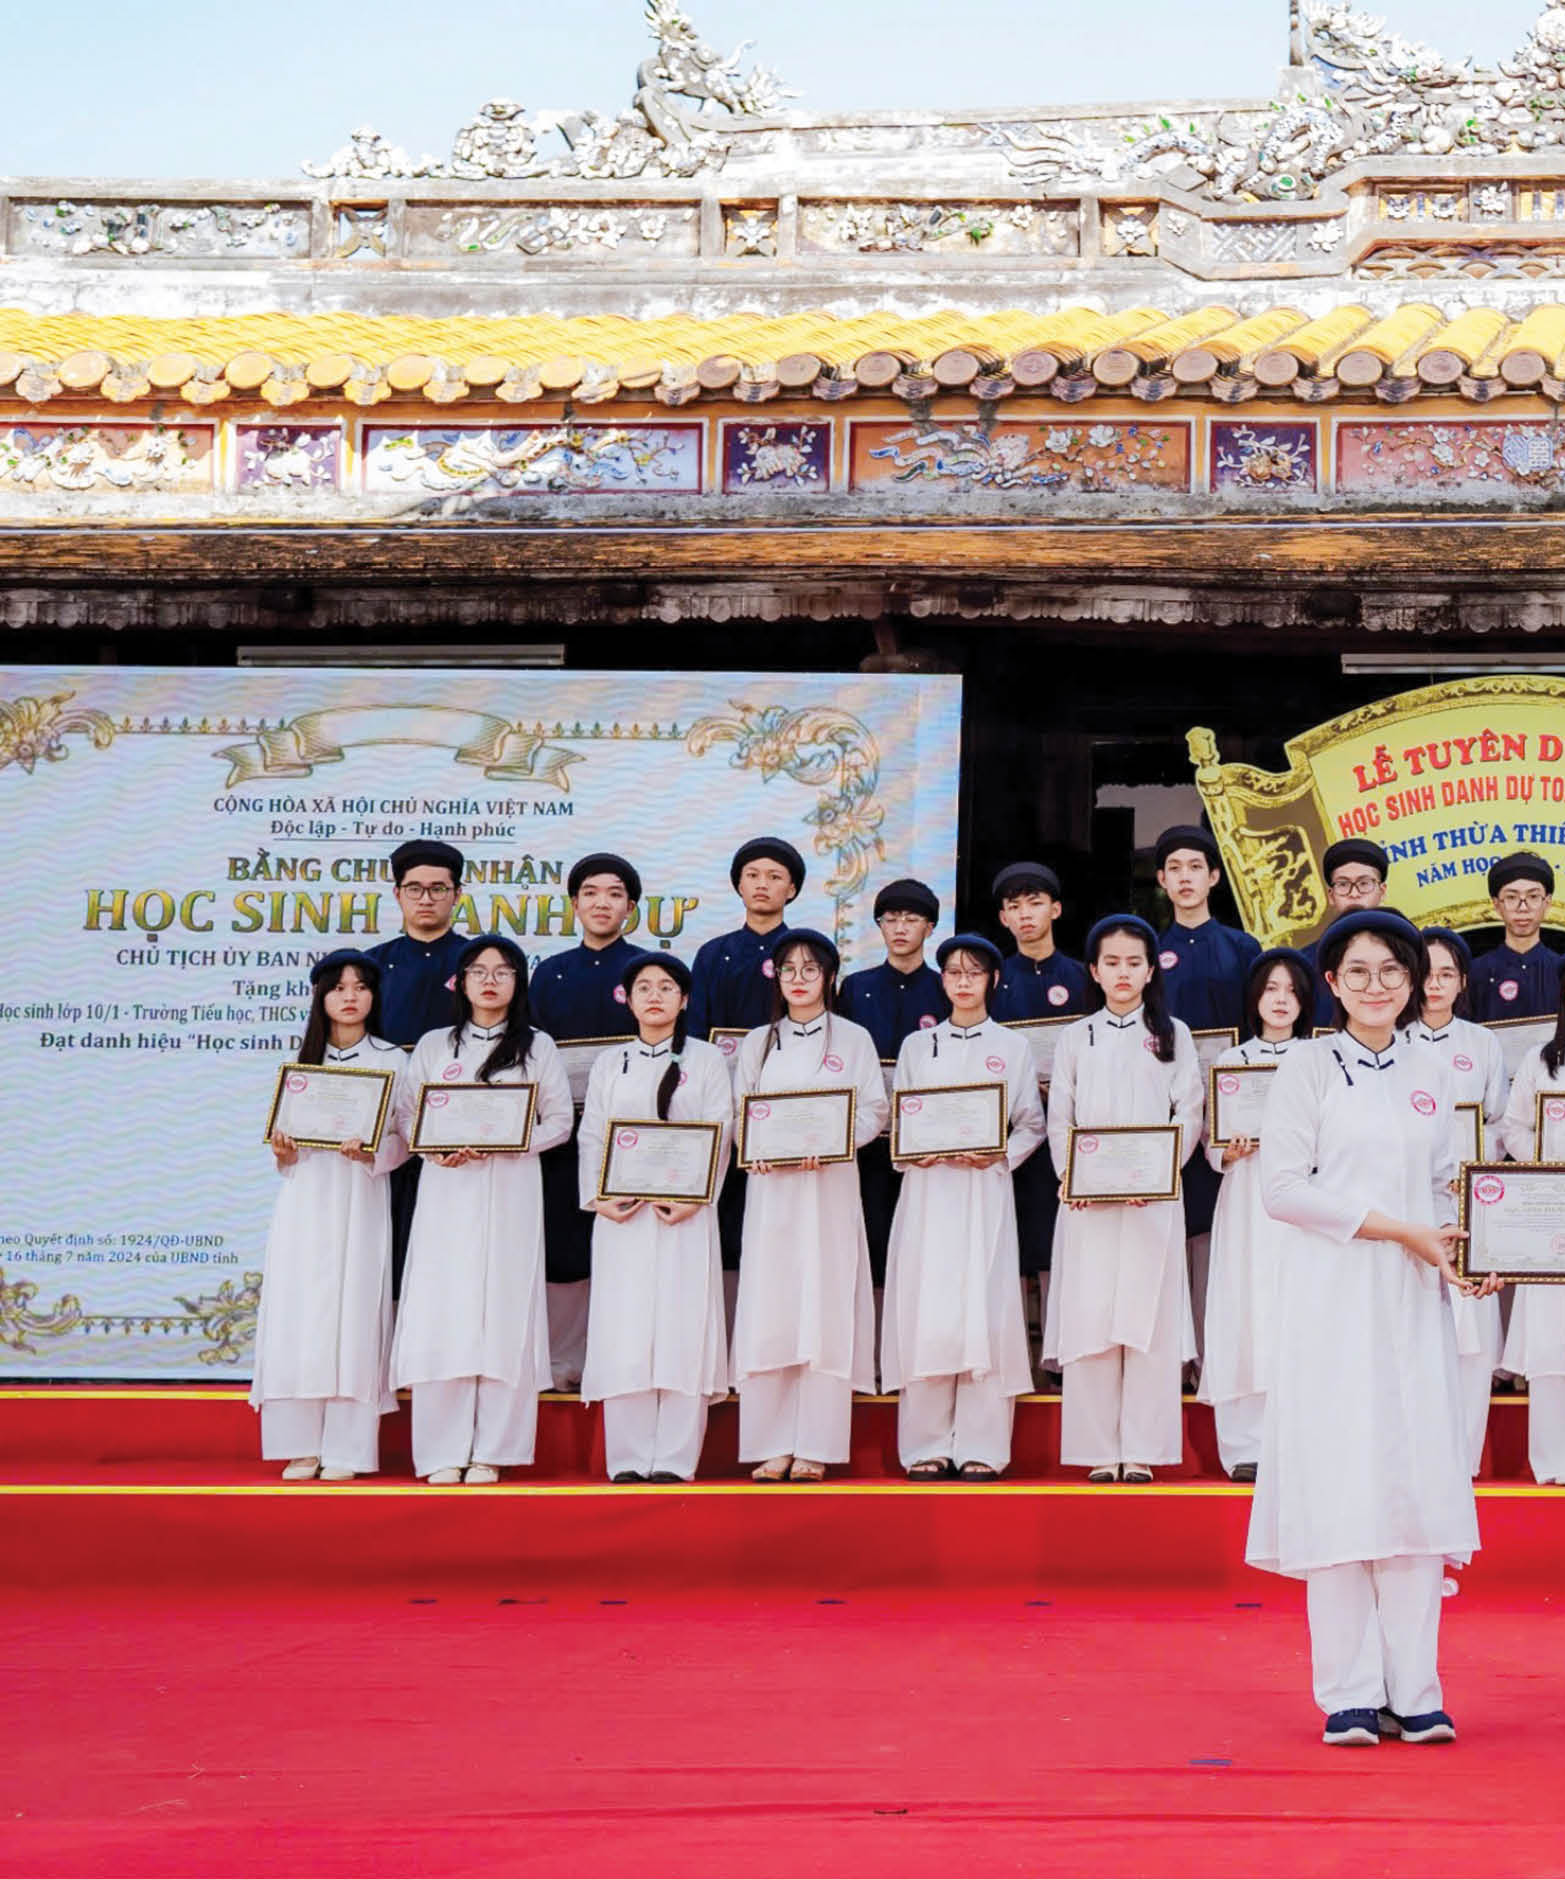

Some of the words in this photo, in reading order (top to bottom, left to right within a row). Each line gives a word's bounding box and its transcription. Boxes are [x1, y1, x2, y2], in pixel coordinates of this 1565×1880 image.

[1353, 744, 1398, 792] LỄ
[1402, 728, 1528, 775] TUYÊN
[214, 797, 264, 814] CỘNG
[269, 797, 307, 813] HÒA
[312, 798, 336, 813] XÃ
[342, 798, 375, 816] HỘI
[380, 797, 417, 814] CHỦ
[422, 799, 480, 815] NGHĨA
[486, 799, 526, 818] VIỆT
[533, 801, 574, 816] NAM
[1338, 802, 1381, 839] HỌC
[1385, 784, 1436, 820] SINH
[1441, 775, 1498, 806] DANH
[1505, 773, 1535, 805] DỰ
[271, 819, 304, 836] Độc
[308, 820, 336, 837] lập
[353, 821, 378, 838] Tự
[382, 821, 405, 836] do
[420, 822, 468, 839] Hạnh
[472, 822, 516, 840] phúc
[1381, 836, 1428, 864] ỈNH
[1432, 820, 1507, 851] THỪA
[227, 847, 322, 882] BẰNG
[1416, 862, 1458, 888] NĂM
[83, 888, 216, 942] HỌC
[231, 890, 383, 934] SINH
[398, 893, 578, 937] ANH
[116, 945, 160, 966] CHỦ
[166, 950, 216, 969] TỊCH
[223, 945, 250, 967] ỦY
[256, 951, 300, 968] BAN
[232, 979, 281, 1000] Tặng
[24, 1003, 54, 1019] sinh
[58, 1002, 83, 1023] lớp
[87, 1003, 119, 1023] 10/1
[133, 1003, 188, 1025] Trường
[259, 1005, 297, 1021] THCS
[40, 1031, 75, 1052] Đạt
[80, 1032, 131, 1048] danh
[138, 1032, 181, 1053] hiệu
[240, 1035, 283, 1050] sinh
[65, 1233, 94, 1247] định
[65, 1250, 74, 1262] 7
[77, 1250, 105, 1262] năm
[108, 1250, 141, 1263] 2024
[145, 1251, 167, 1263] của
[171, 1251, 209, 1263] UBND
